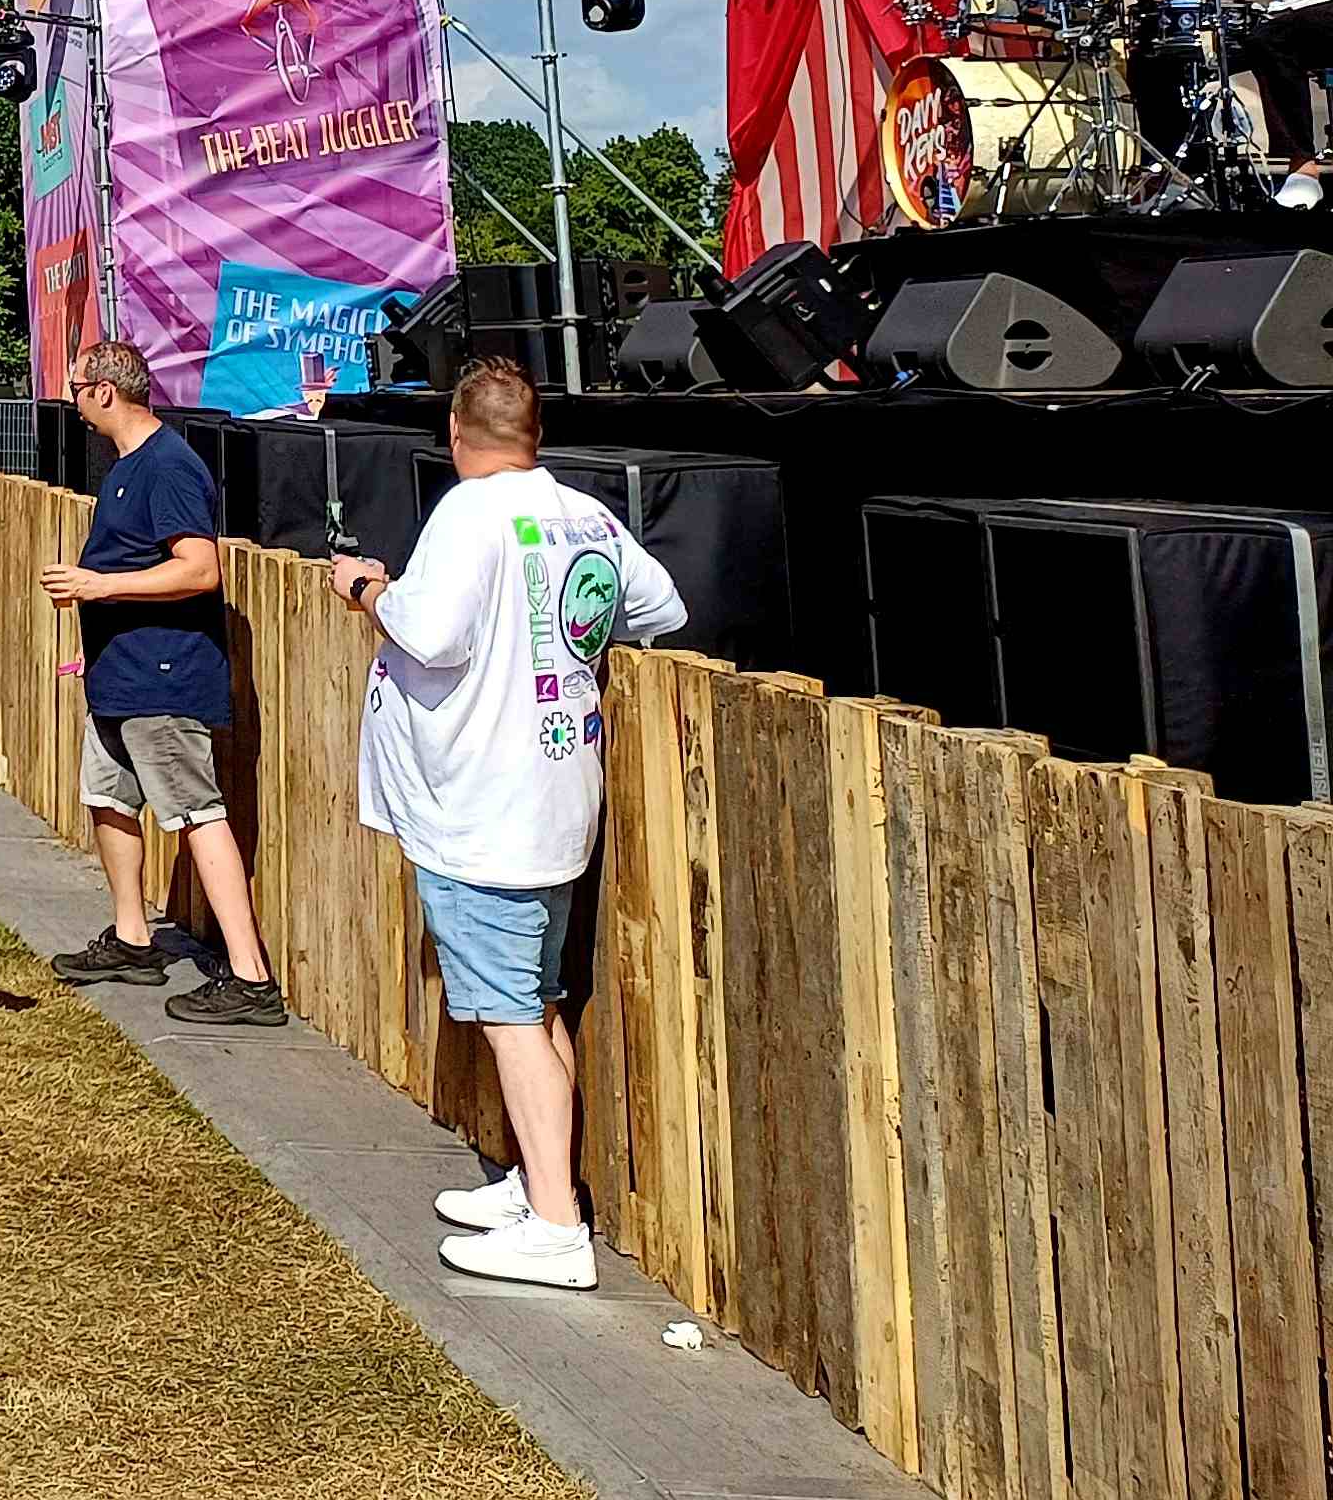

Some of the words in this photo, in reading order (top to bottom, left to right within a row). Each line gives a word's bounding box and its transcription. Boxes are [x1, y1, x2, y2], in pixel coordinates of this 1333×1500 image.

[199, 129, 250, 175] THE
[251, 118, 309, 166] BEAT
[318, 100, 420, 156] JUGGLER
[898, 87, 943, 146] DAVY
[905, 124, 947, 183] KEYS
[232, 287, 283, 323] THE
[226, 319, 259, 344] OF
[264, 325, 367, 365] SYMPHO
